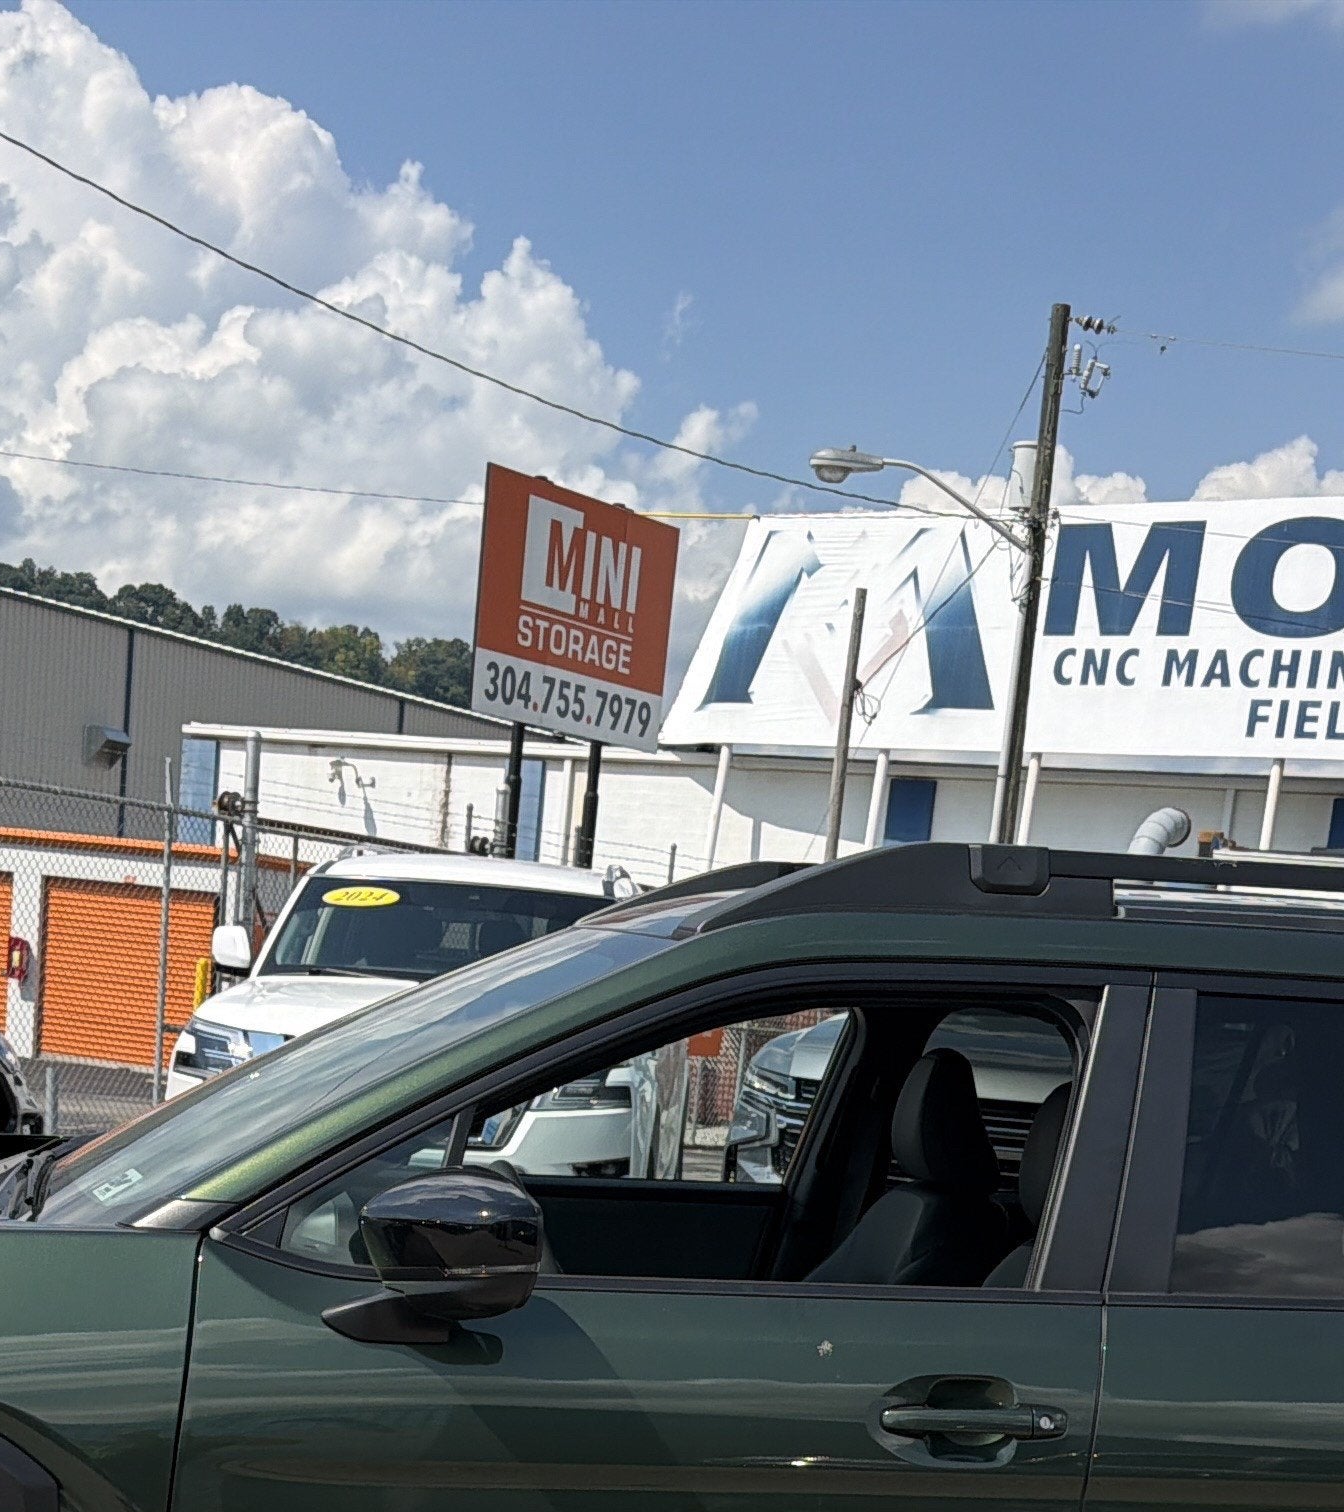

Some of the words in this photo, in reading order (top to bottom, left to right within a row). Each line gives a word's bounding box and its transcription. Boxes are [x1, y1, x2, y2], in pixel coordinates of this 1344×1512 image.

[544, 517, 642, 615] MINI
[578, 600, 635, 634] MALL
[516, 614, 633, 675] STORAGE
[1053, 647, 1140, 686] CNC
[483, 660, 652, 739] 304.755.7979
[334, 891, 391, 902] 2024
